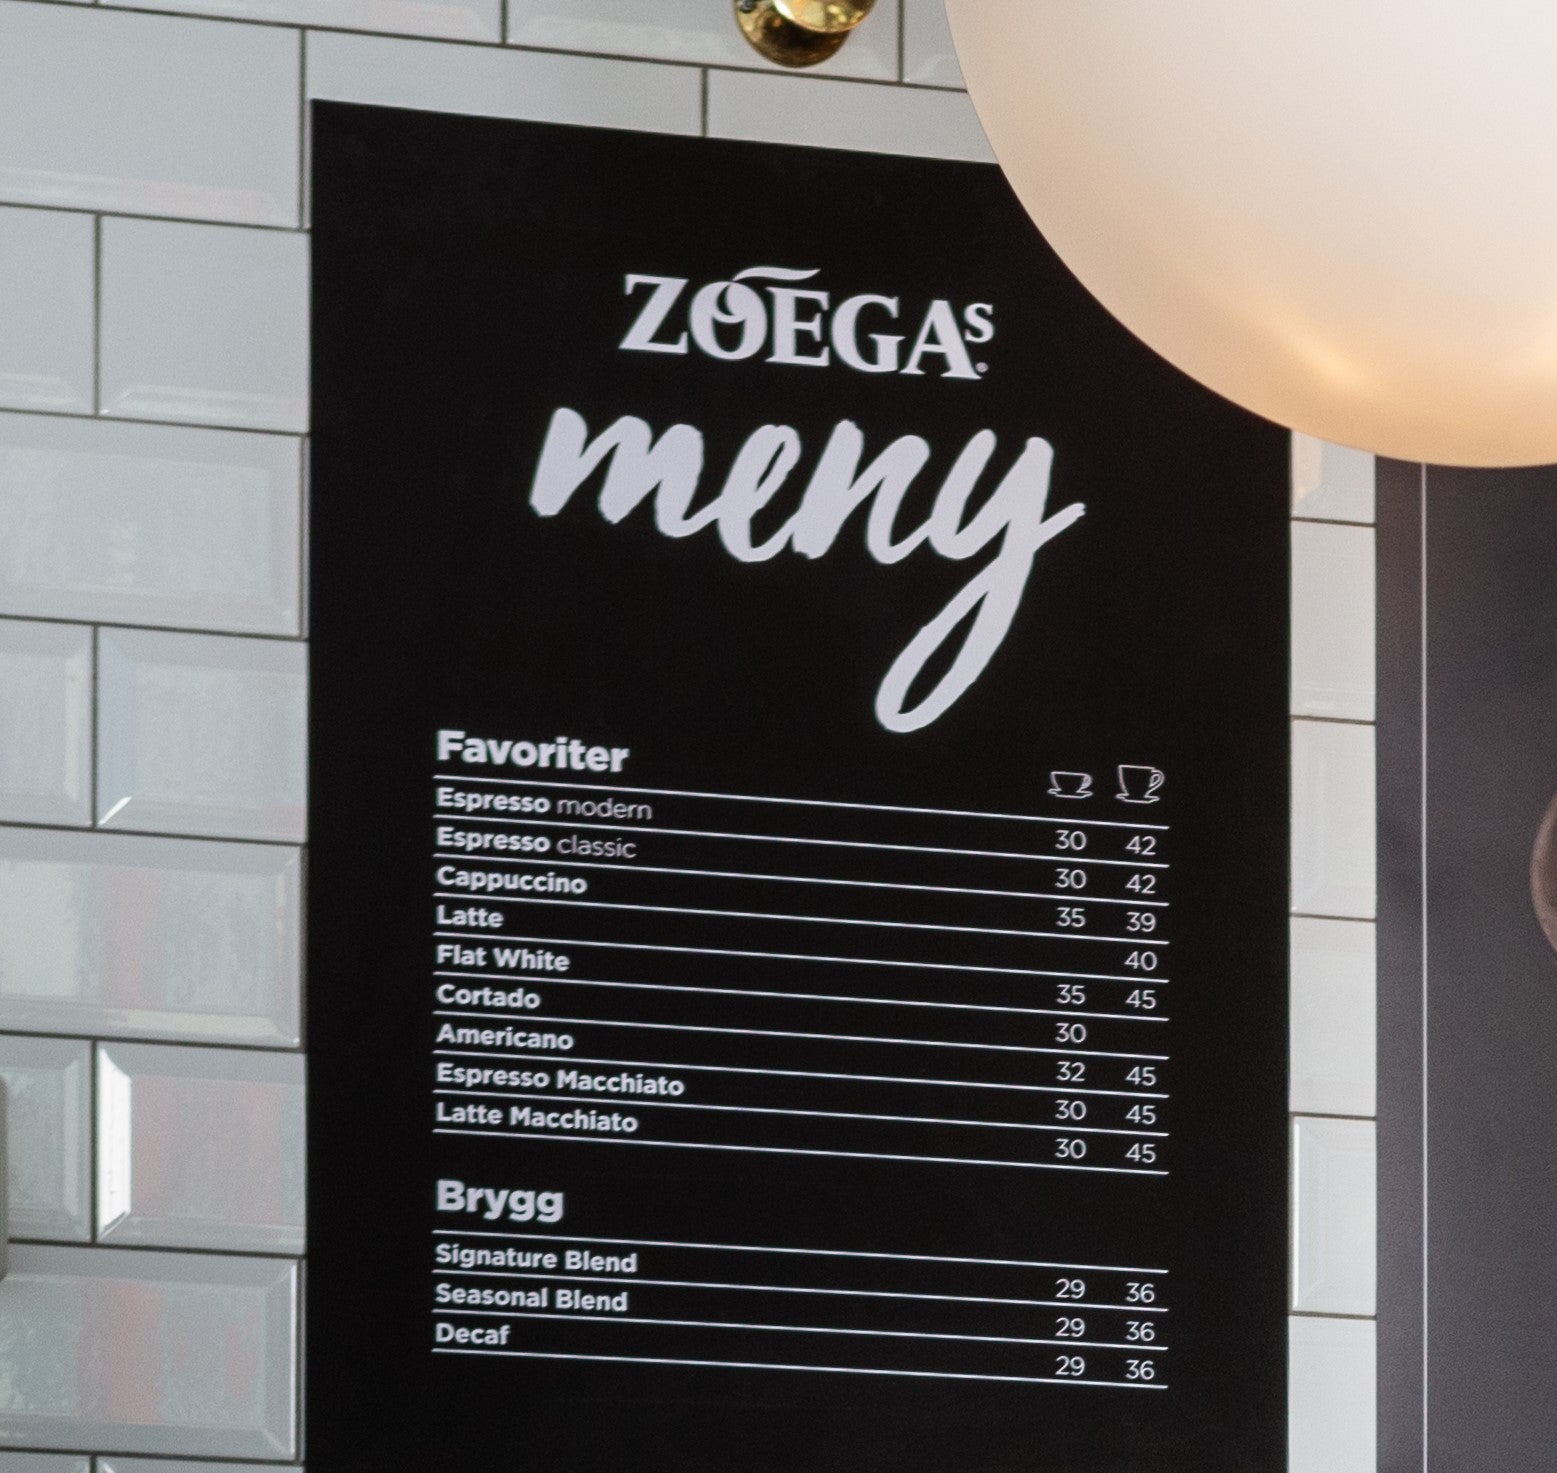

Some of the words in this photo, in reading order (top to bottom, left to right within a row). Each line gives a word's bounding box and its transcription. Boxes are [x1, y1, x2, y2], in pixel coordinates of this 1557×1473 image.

[527, 406, 1085, 734] meny
[436, 730, 629, 773] Favoriter
[436, 788, 550, 816] Espresso
[557, 796, 652, 821] modern
[1055, 830, 1087, 851] 30
[1125, 835, 1157, 857] 42
[436, 827, 550, 856] Espresso
[557, 834, 636, 860] classic
[1055, 869, 1087, 890] 30
[1125, 873, 1157, 895] 42
[436, 866, 588, 896] Cappuccino
[1055, 907, 1087, 928] 35
[1125, 912, 1157, 934] 39
[436, 906, 504, 928] Latte
[1125, 950, 1157, 972] 40
[436, 945, 487, 967] Flat
[493, 948, 570, 972] White
[1055, 983, 1087, 1005] 35
[1125, 988, 1157, 1010] 45
[436, 984, 541, 1010] Cortado
[1055, 1022, 1087, 1043] 30
[436, 1024, 574, 1050] Americano
[1055, 1061, 1087, 1082] 32
[1125, 1065, 1157, 1087] 45
[436, 1063, 550, 1091] Espresso
[556, 1068, 684, 1097] Macchiato
[1055, 1099, 1087, 1121] 30
[1125, 1104, 1157, 1126] 45
[436, 1102, 502, 1126] Latte
[509, 1106, 638, 1133] Macchiato
[1055, 1138, 1087, 1159] 30
[1125, 1142, 1157, 1164] 45
[436, 1178, 565, 1222] Brygg
[434, 1243, 558, 1273] Signature
[564, 1248, 637, 1273] Blend
[1055, 1278, 1087, 1299] 29
[1125, 1282, 1157, 1304] 36
[434, 1283, 549, 1310] Seasonal
[555, 1288, 628, 1312] Blend
[1055, 1317, 1087, 1338] 29
[1125, 1320, 1157, 1342] 36
[434, 1322, 511, 1346] Decaf
[1055, 1355, 1087, 1377] 29
[1125, 1359, 1157, 1381] 36
